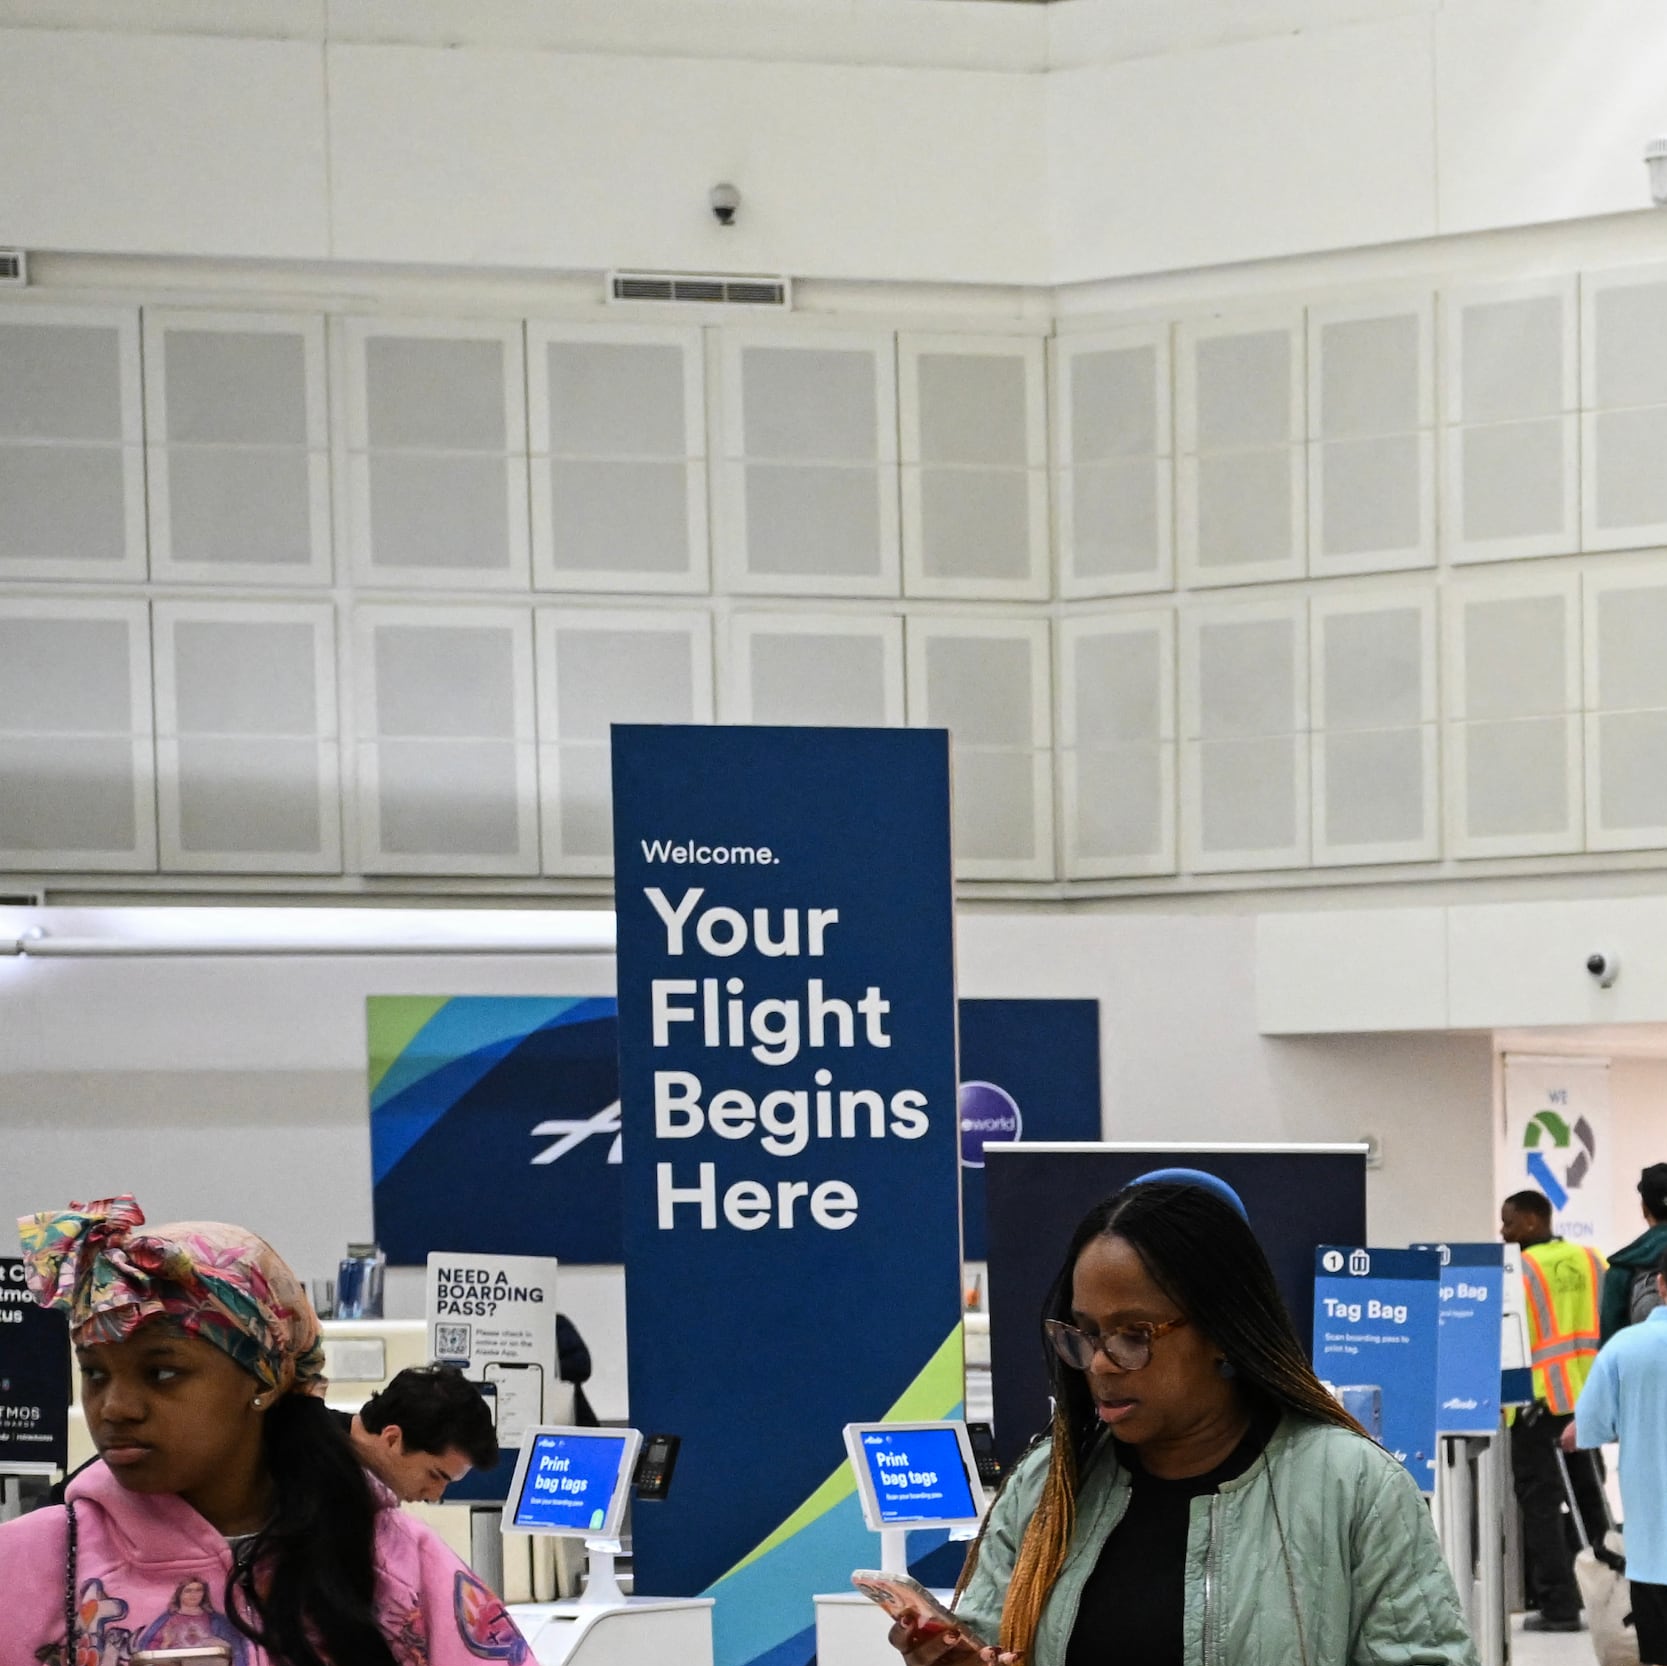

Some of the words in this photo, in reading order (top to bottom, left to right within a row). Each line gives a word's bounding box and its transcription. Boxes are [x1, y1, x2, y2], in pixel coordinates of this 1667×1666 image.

[641, 839, 780, 865] Welcome.
[643, 887, 838, 957] Your
[651, 977, 891, 1066] Flight
[654, 1068, 929, 1157] Begins
[657, 1161, 858, 1231] Here
[437, 1268, 490, 1284] NEED
[494, 1270, 508, 1286] A
[437, 1284, 544, 1304] BOARDING
[1457, 1283, 1488, 1302] Bag
[437, 1300, 497, 1317] PASS?
[1322, 1298, 1362, 1323] Tag
[1367, 1299, 1408, 1324] Bag
[539, 1455, 570, 1472] Print
[876, 1451, 909, 1467] Print
[534, 1474, 559, 1494] bag
[560, 1475, 588, 1495] tags
[880, 1470, 908, 1488] bag
[908, 1470, 938, 1487] tags
